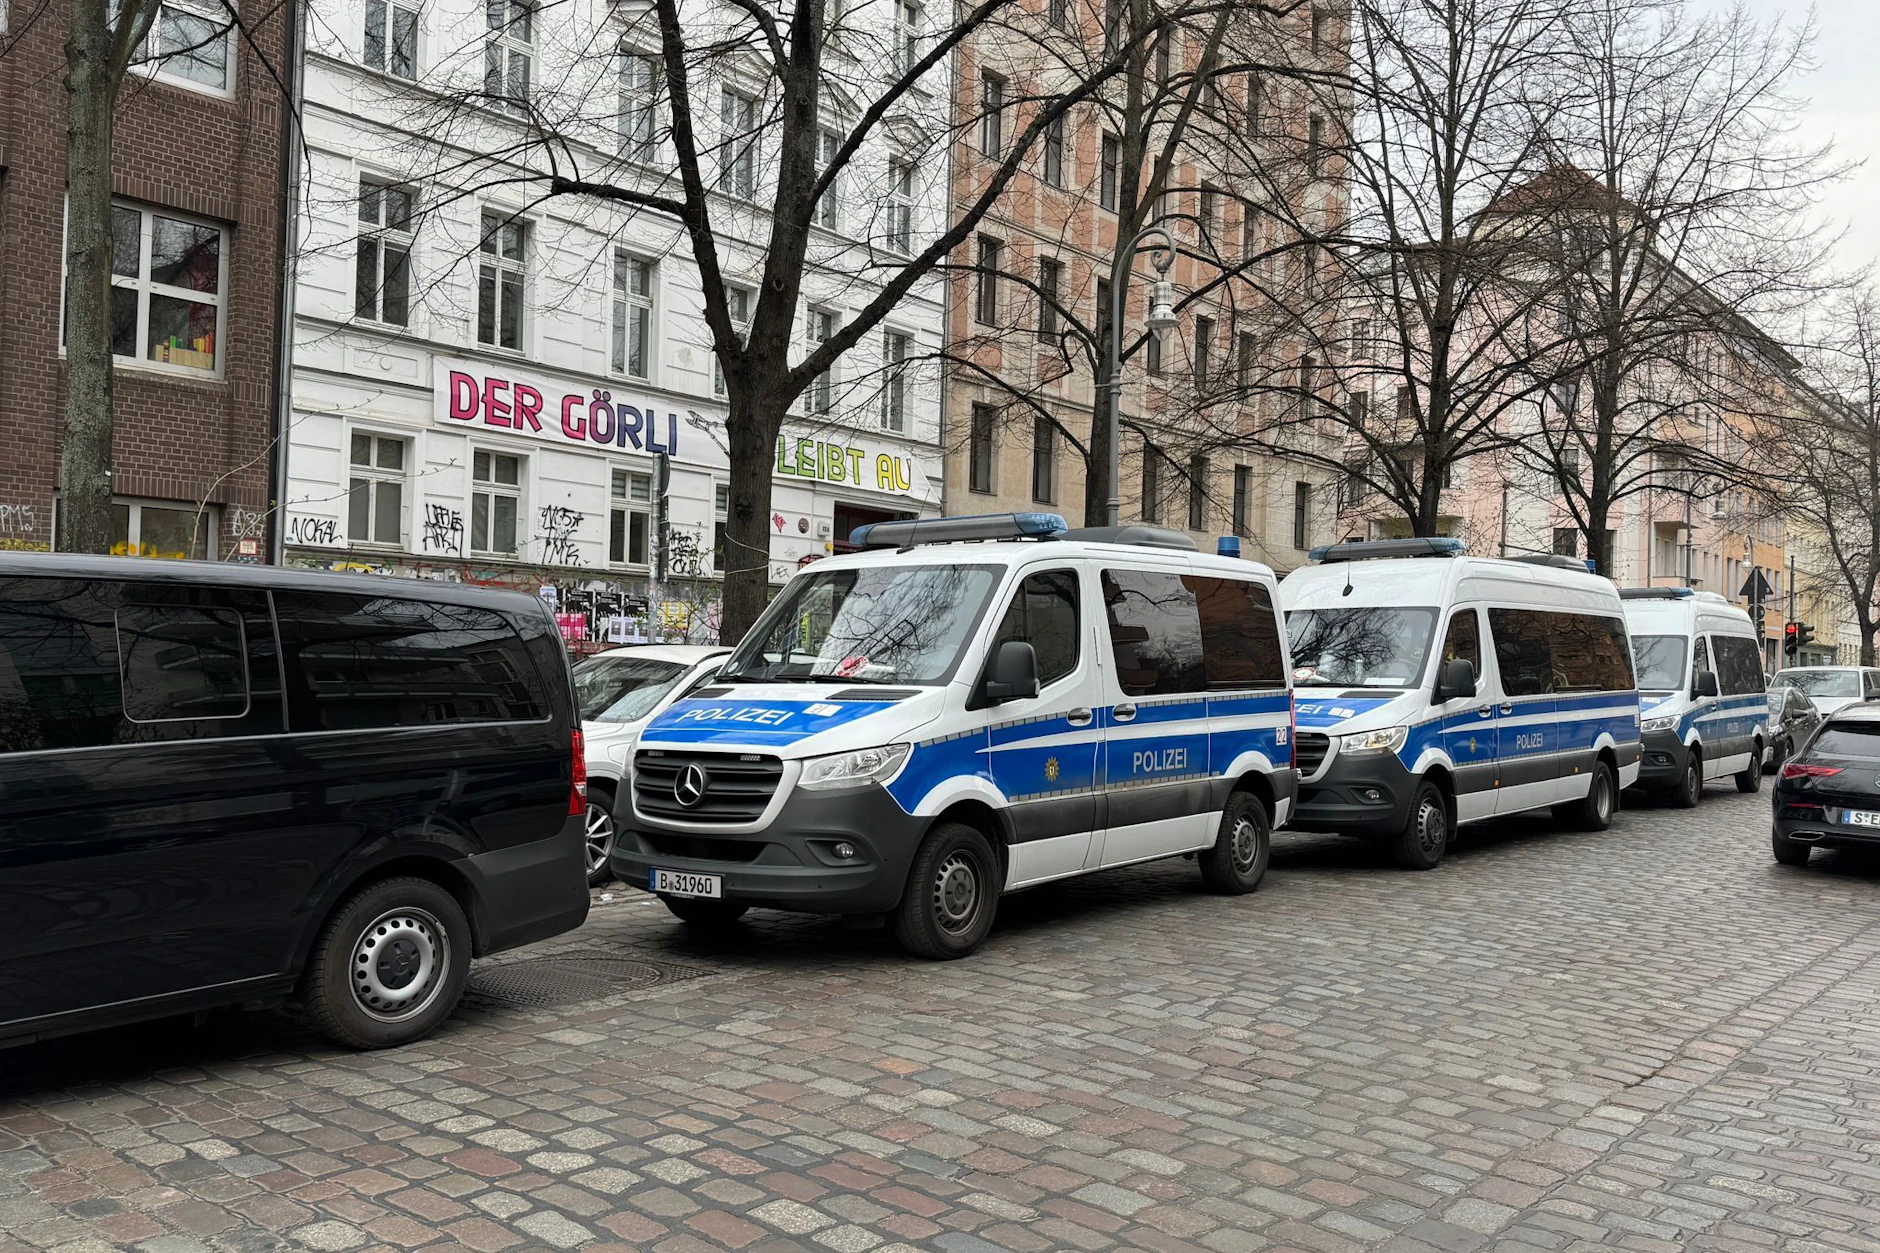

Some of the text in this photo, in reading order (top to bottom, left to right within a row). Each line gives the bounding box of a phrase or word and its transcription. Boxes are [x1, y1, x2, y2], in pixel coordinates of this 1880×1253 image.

[450, 370, 544, 432] DER
[561, 389, 677, 457] GÖRLI
[778, 434, 865, 485] LEIBT
[674, 707, 795, 725] POLIZEI
[1516, 732, 1543, 749] POLIZEI
[1133, 748, 1187, 773] POLIZEI
[1870, 814, 1880, 826] E
[674, 874, 712, 894] 31960
